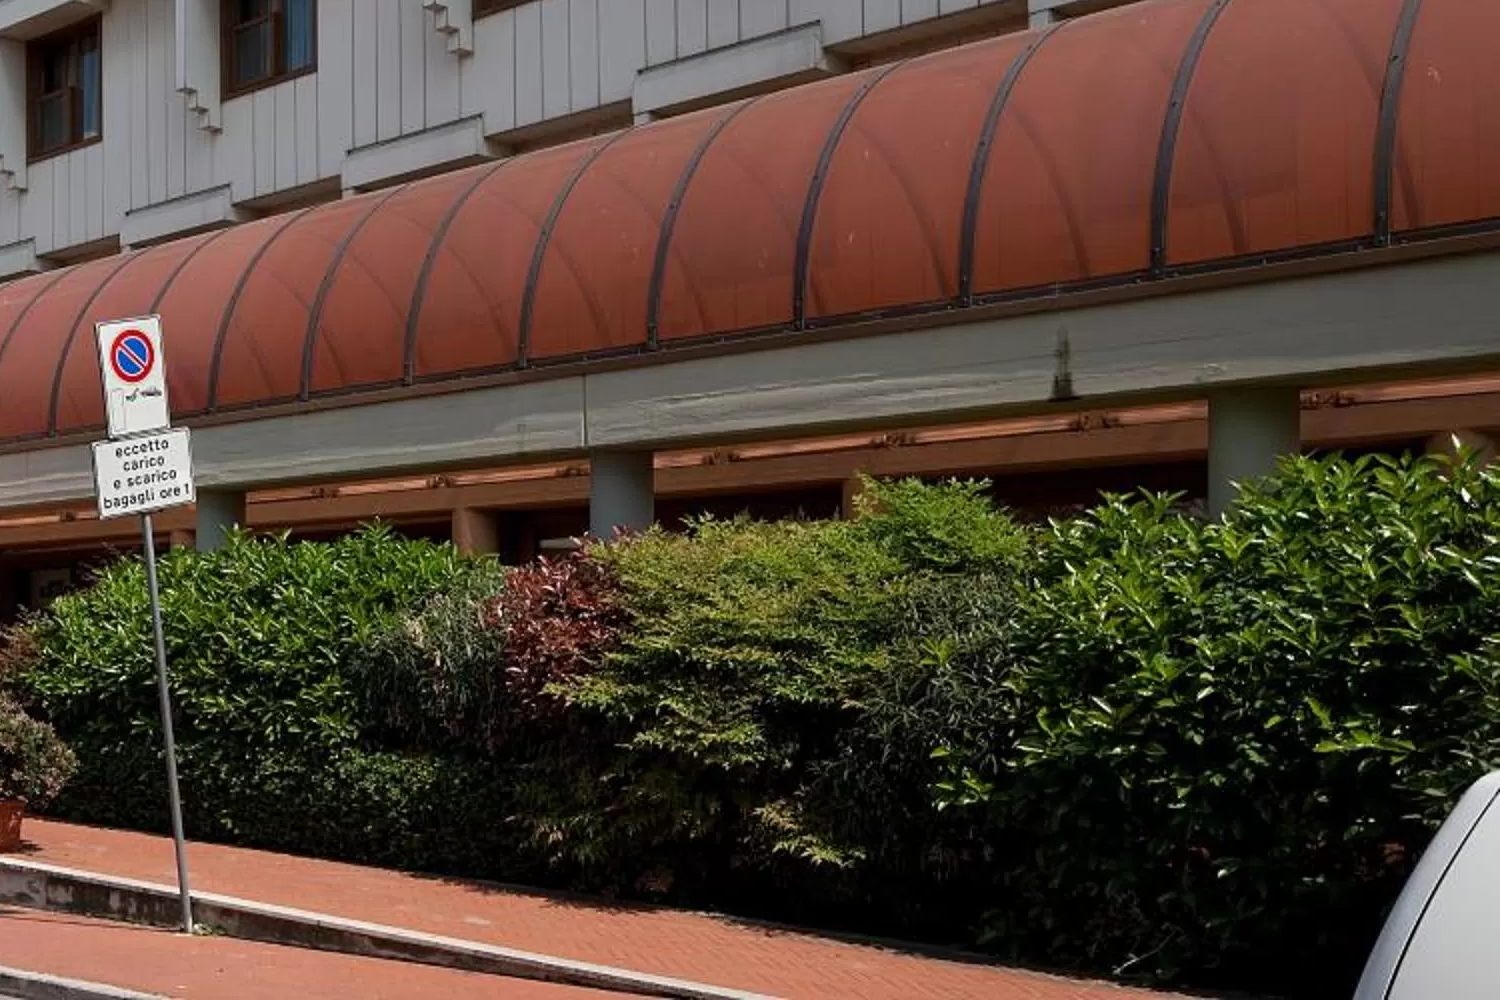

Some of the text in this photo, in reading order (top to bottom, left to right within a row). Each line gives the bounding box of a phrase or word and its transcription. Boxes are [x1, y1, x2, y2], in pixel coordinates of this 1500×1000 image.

[115, 440, 169, 457] eccetto
[123, 456, 165, 471] carico
[113, 469, 177, 490] e scarico
[104, 488, 155, 509] bagagli
[160, 487, 181, 499] ore
